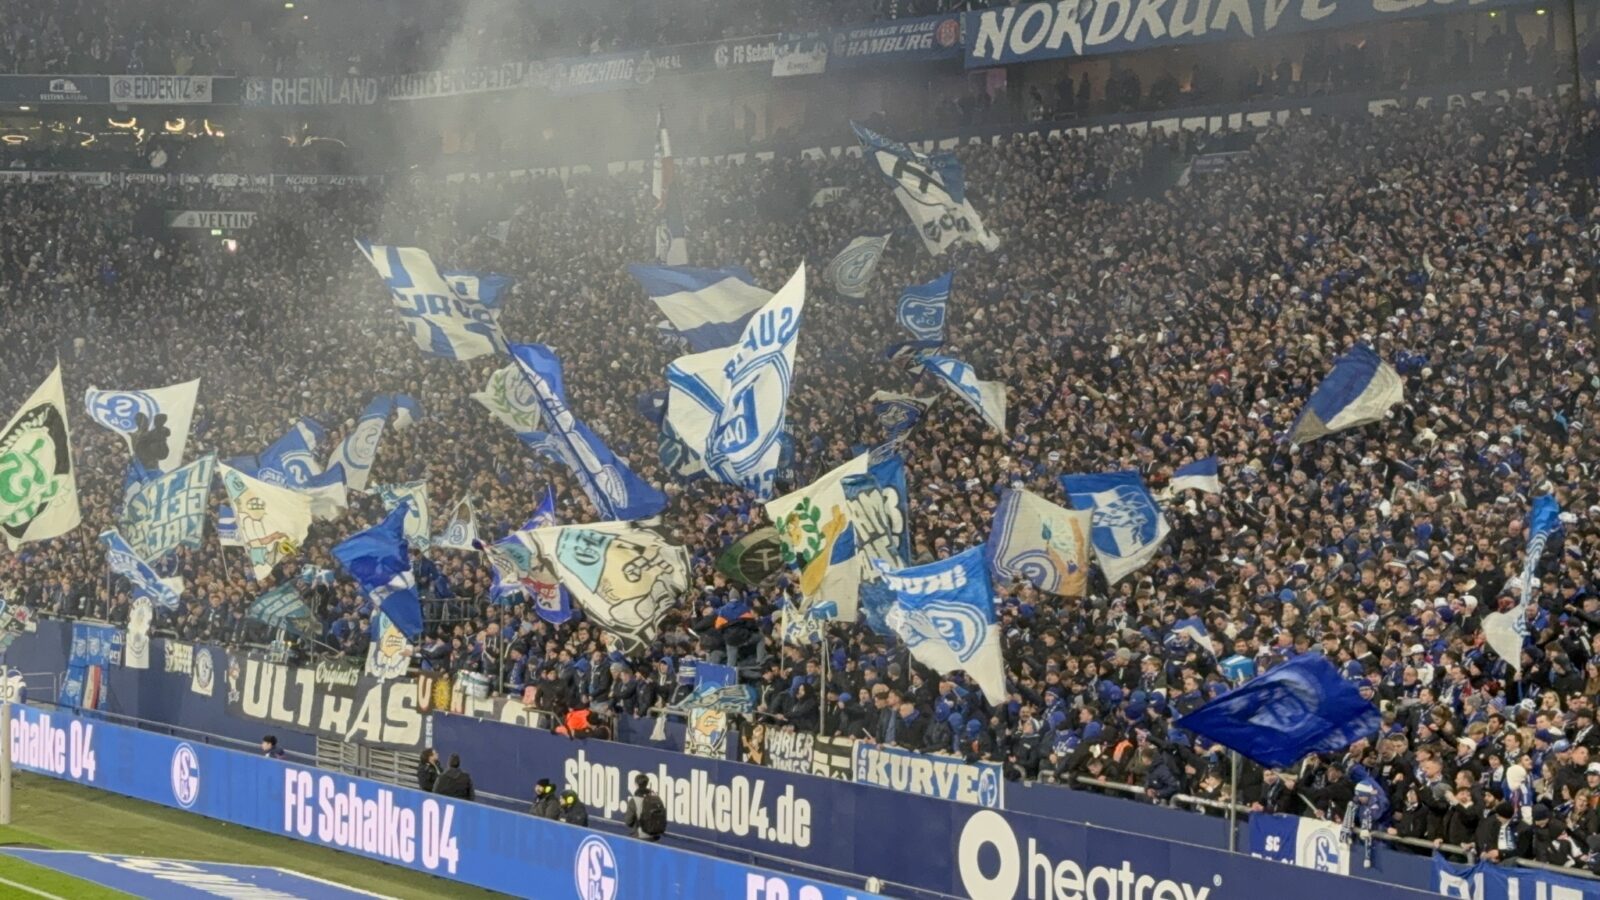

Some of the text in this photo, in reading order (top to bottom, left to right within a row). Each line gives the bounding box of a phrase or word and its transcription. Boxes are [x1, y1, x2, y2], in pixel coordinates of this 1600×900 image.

[847, 33, 934, 57] HAMBURG
[134, 77, 191, 99] EDDERITZ
[271, 77, 378, 105] RHEINLAND
[198, 213, 258, 228] VELTINS
[10, 709, 96, 782] chalke 04
[764, 725, 814, 763] MARLER
[867, 748, 979, 805] KURVE
[284, 767, 459, 874] FC Schalke 04
